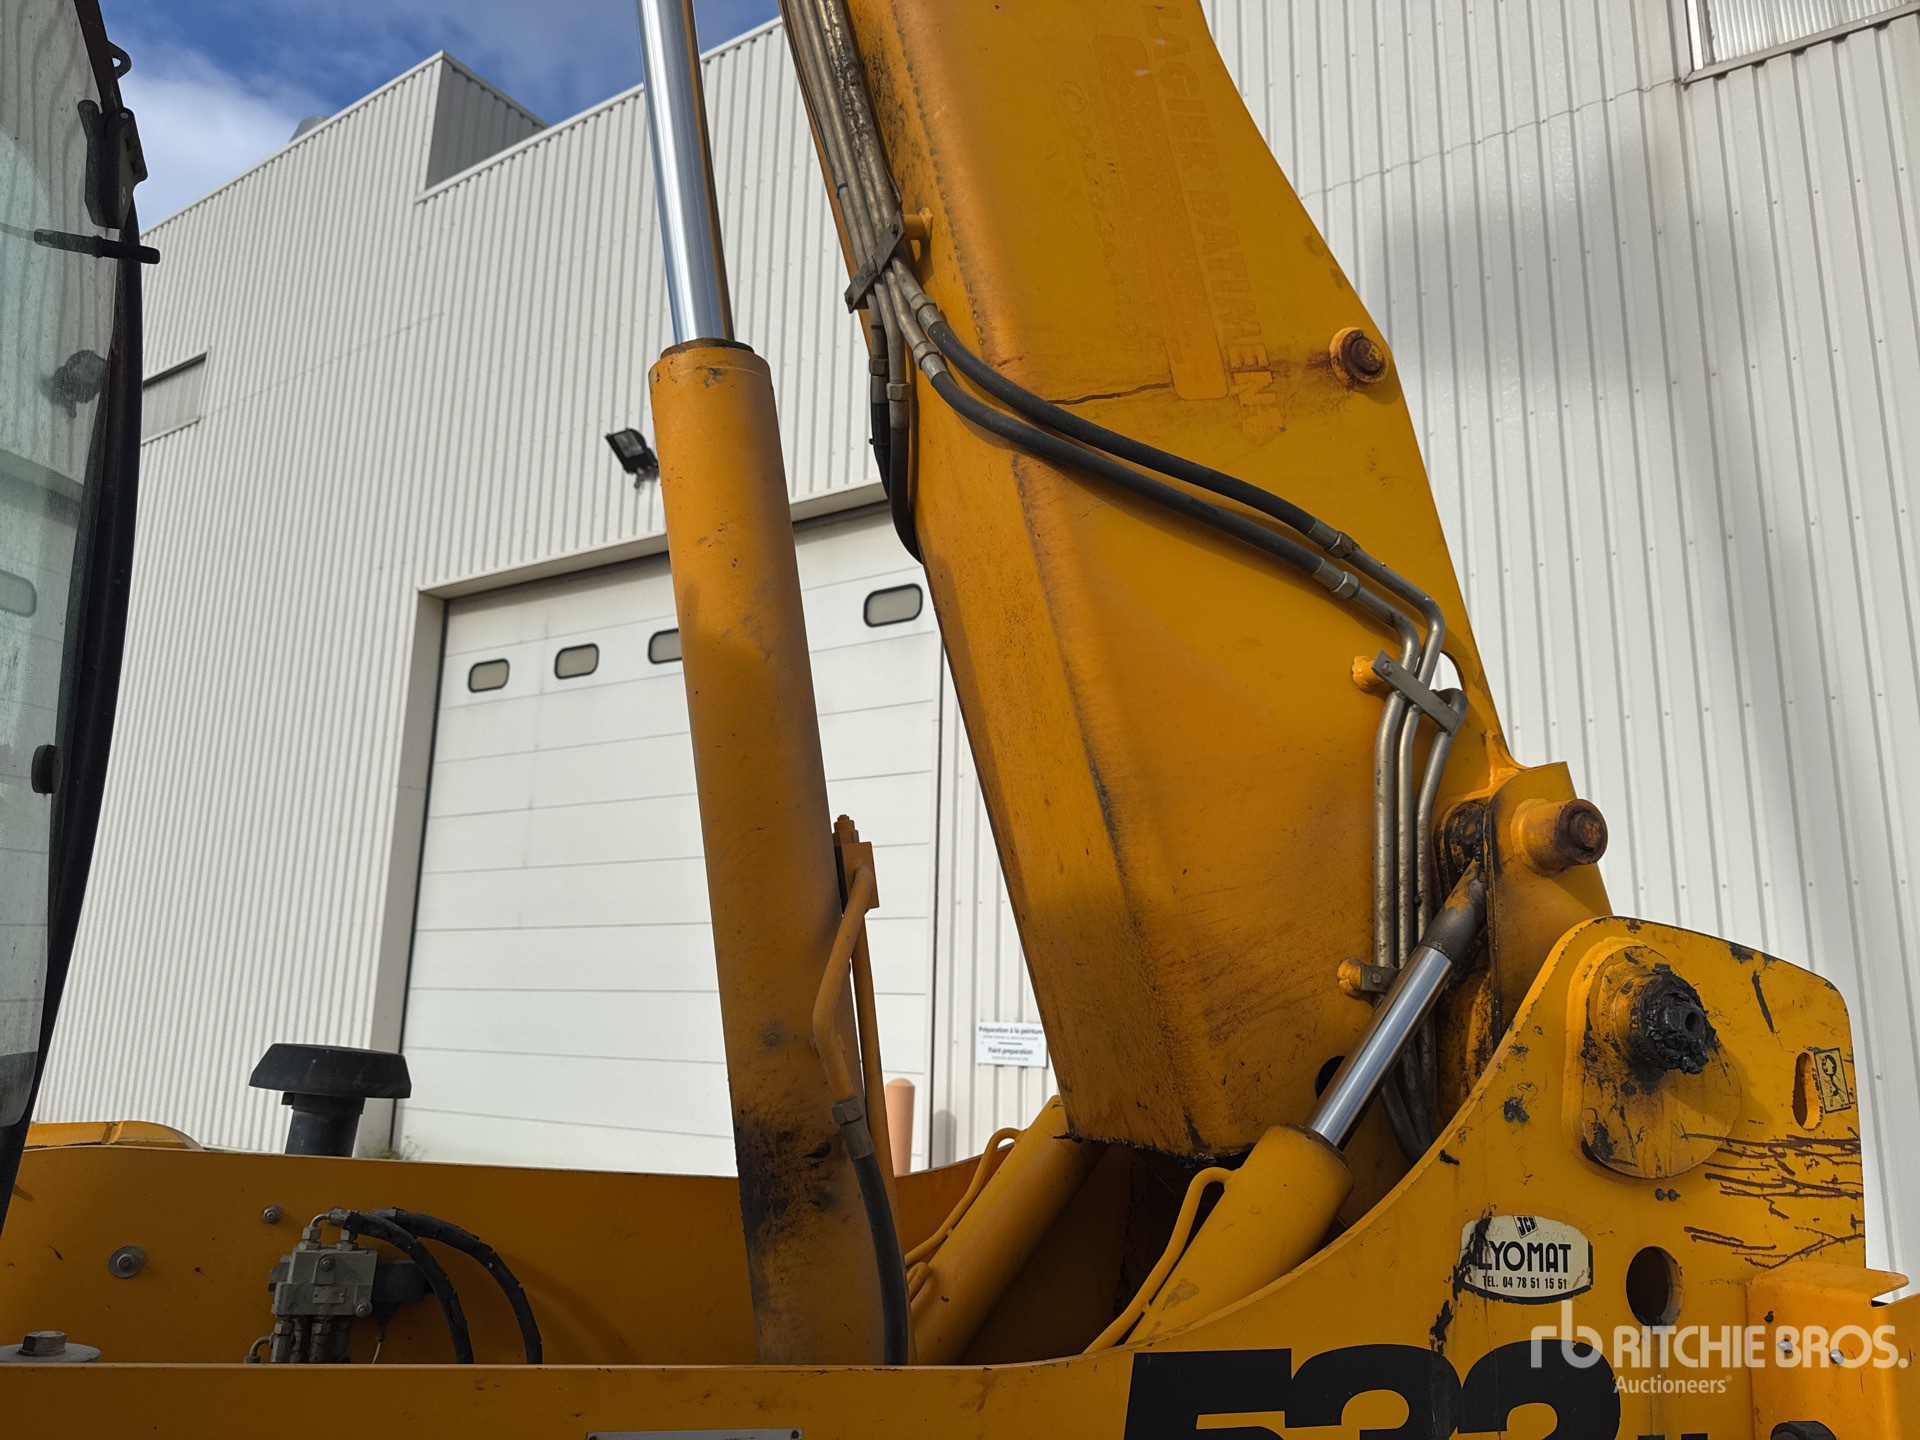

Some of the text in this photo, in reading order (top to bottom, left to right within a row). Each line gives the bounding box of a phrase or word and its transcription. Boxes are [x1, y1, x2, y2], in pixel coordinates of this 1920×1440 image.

[1516, 1216, 1537, 1237] JCB
[1478, 1241, 1571, 1273] LYOMAT
[1483, 1275, 1567, 1289] TEL. 04 78 51 15 51
